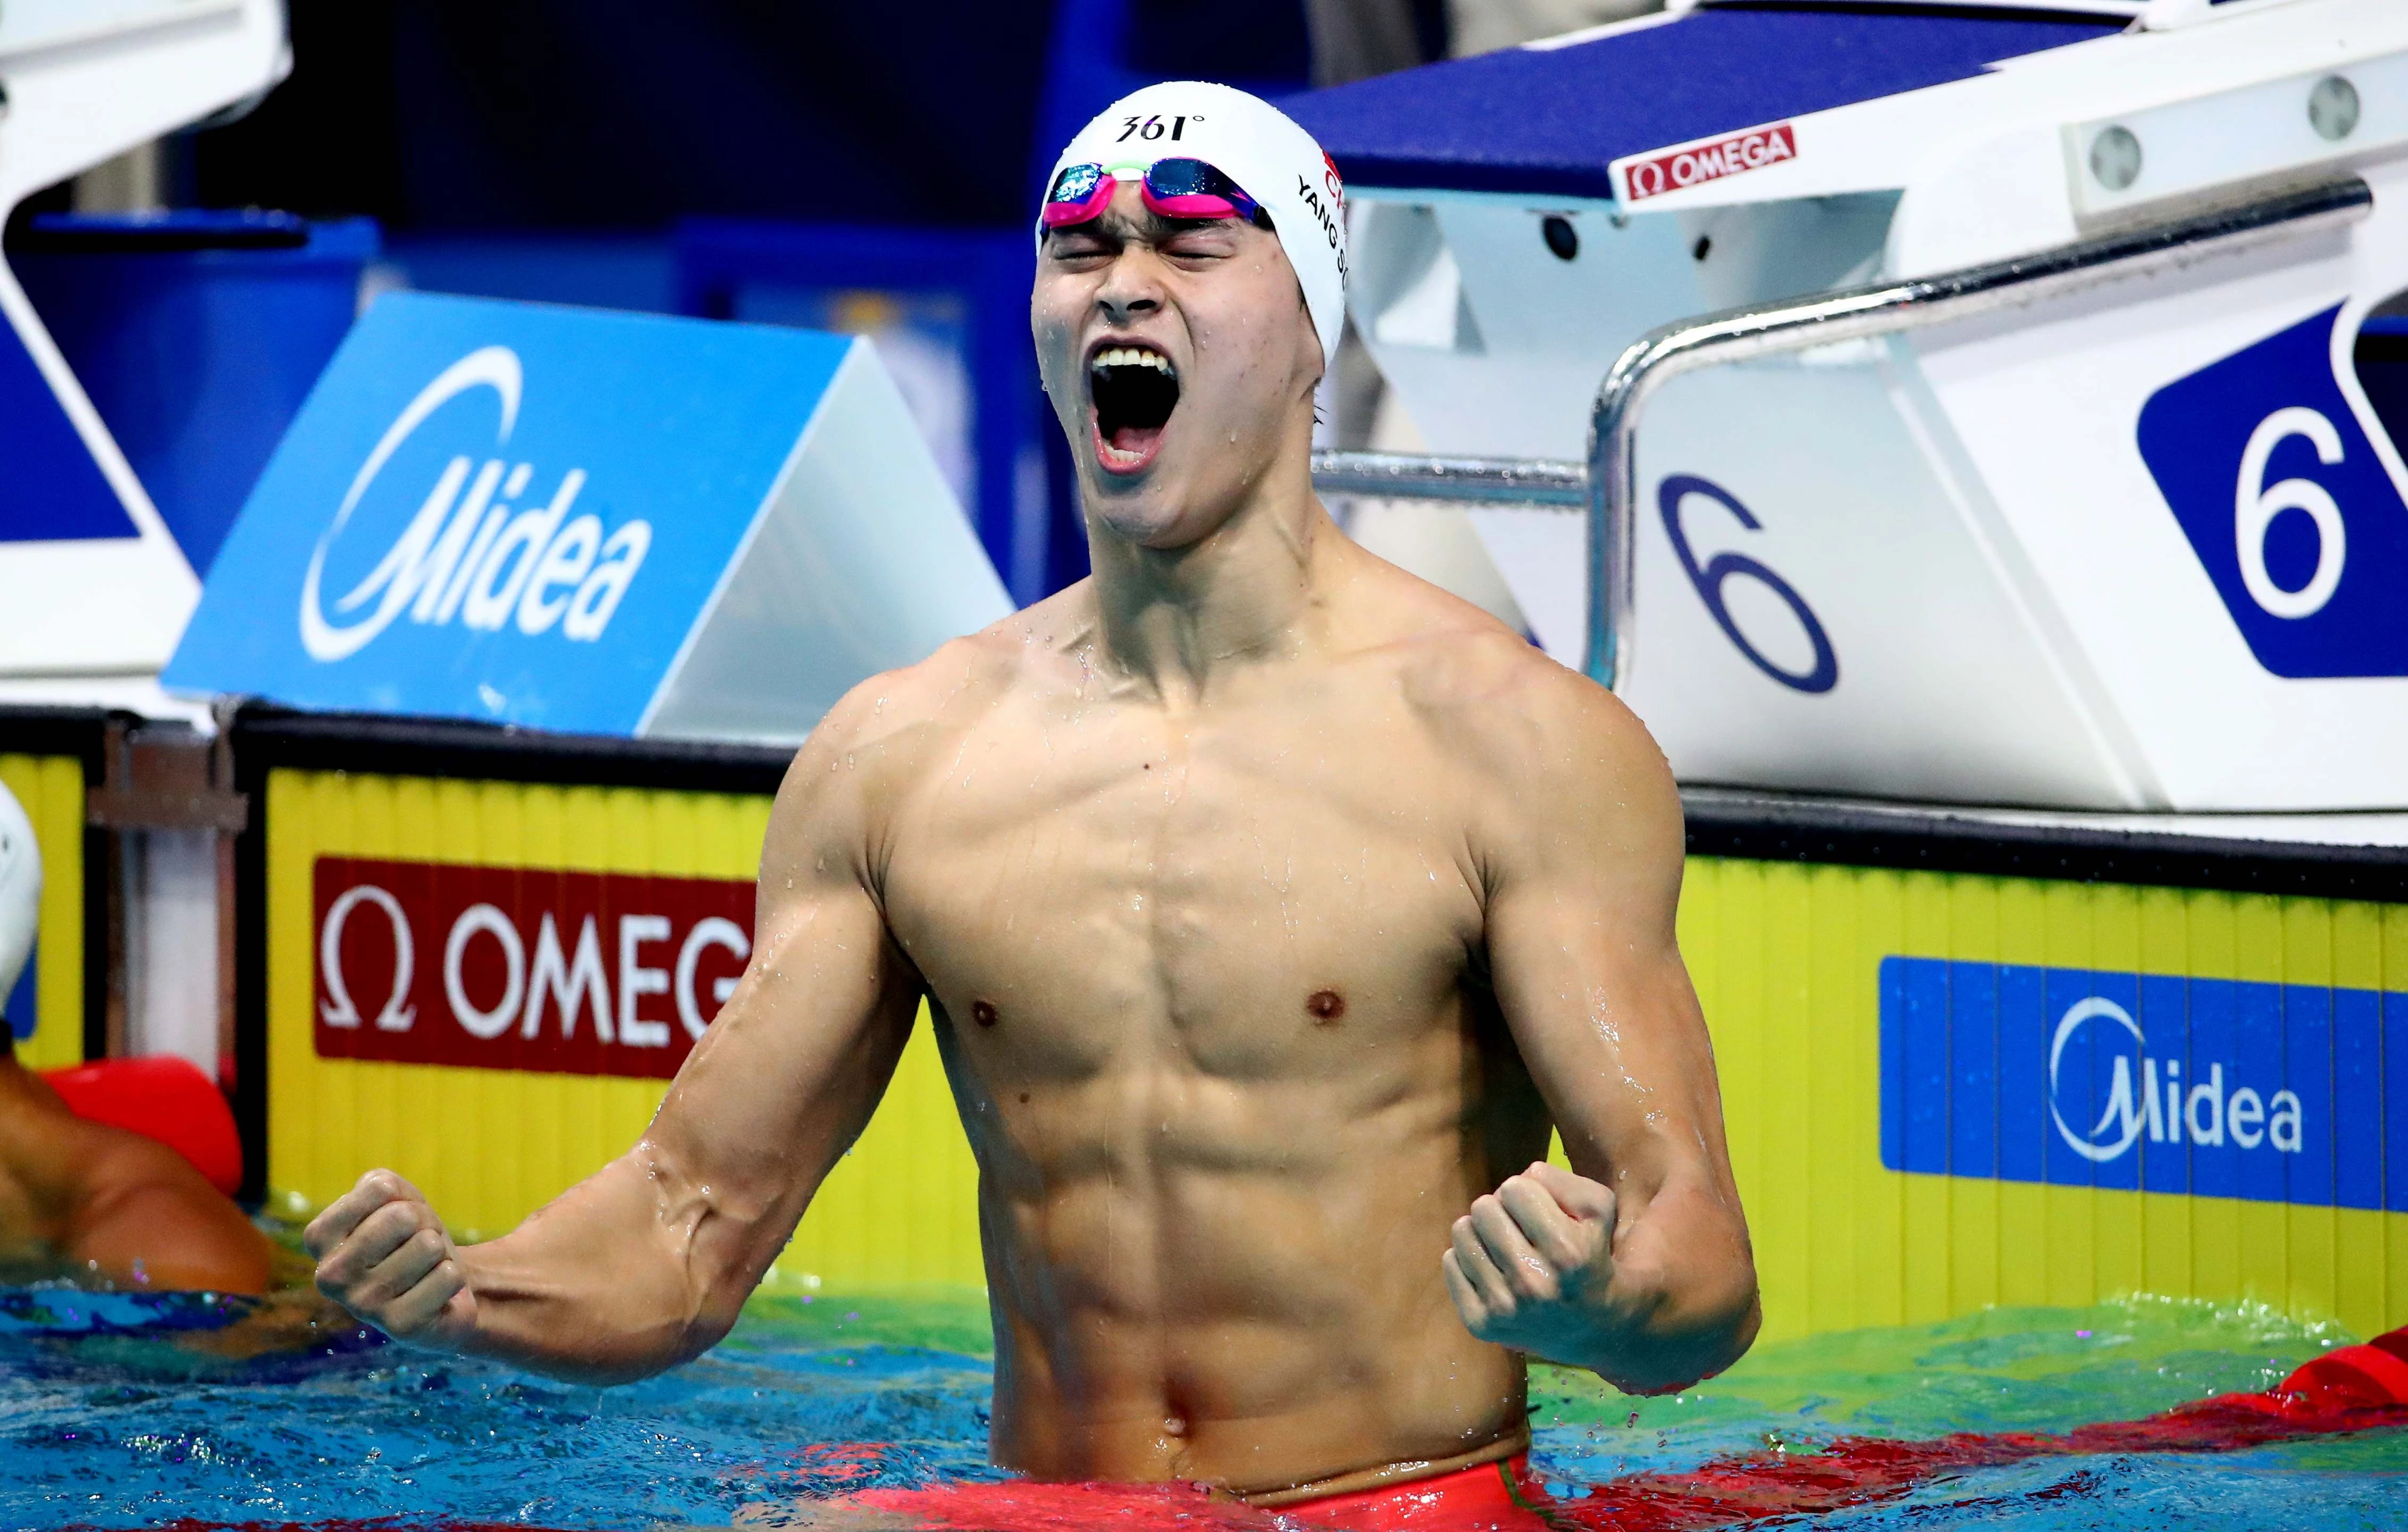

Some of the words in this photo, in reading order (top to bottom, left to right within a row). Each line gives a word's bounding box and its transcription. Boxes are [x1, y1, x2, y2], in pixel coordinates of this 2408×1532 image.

[1298, 173, 1338, 249] YANG
[1671, 130, 1793, 187] OMEGA
[299, 345, 653, 663] Midea
[1656, 472, 1839, 694] 6
[2235, 406, 2346, 620] 6
[443, 902, 750, 1048] OMEG
[2050, 997, 2302, 1162] Midea
